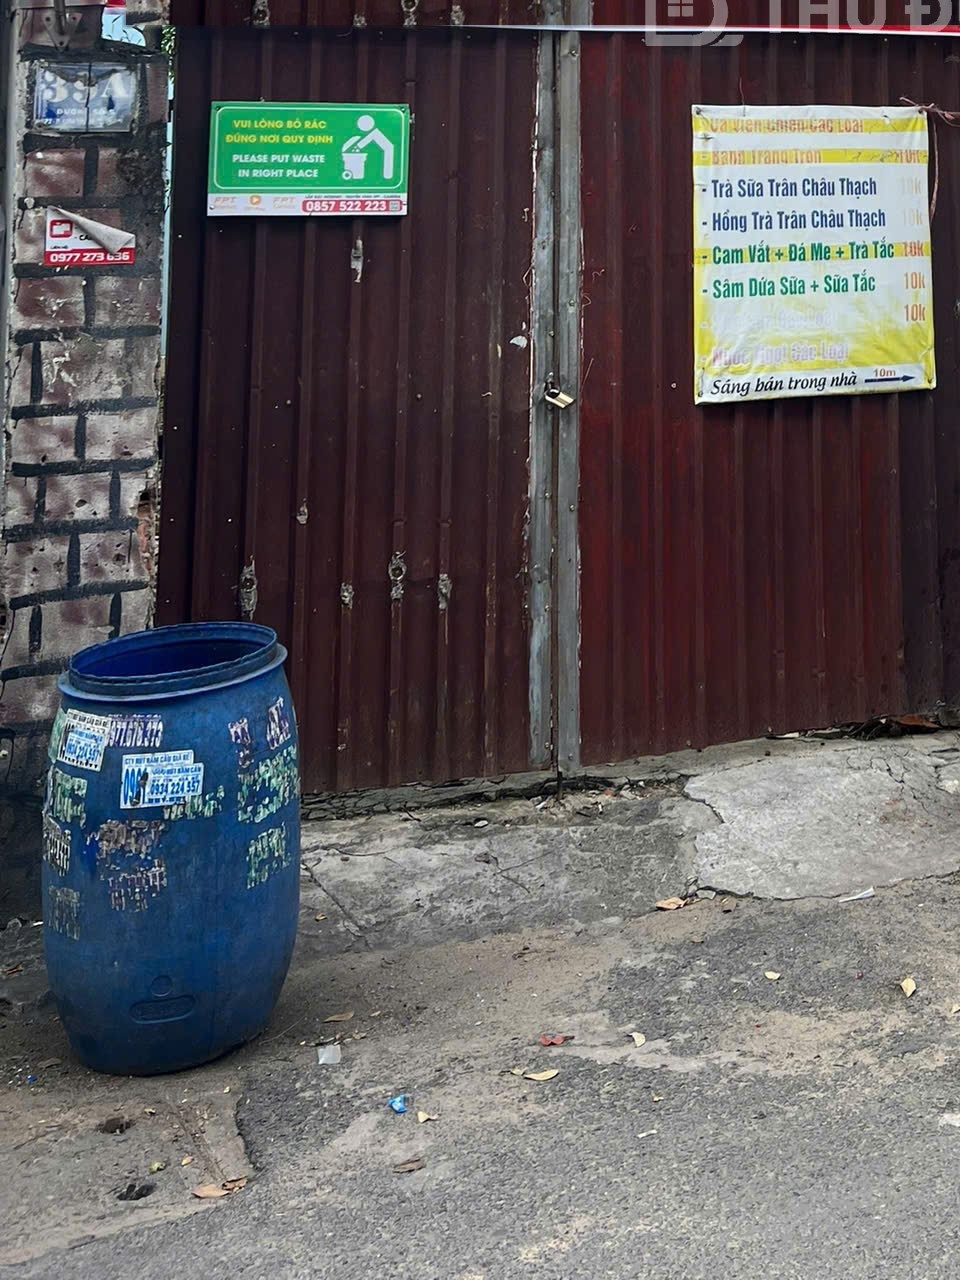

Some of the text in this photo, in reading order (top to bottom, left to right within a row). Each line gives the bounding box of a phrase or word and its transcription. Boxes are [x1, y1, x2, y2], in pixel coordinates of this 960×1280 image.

[233, 118, 327, 129] VUI LÒNG BỎ RÁC
[225, 132, 333, 145] ĐÚNG NƠI QUY ĐỊNH
[232, 154, 325, 163] PLEASE PUT WASTE
[238, 169, 318, 178] IN RIGHT PLACE
[712, 178, 733, 198] Trà
[738, 178, 764, 198] Sữa
[768, 178, 797, 197] Trân
[802, 178, 835, 197] Châu
[839, 177, 877, 199] Thạch
[306, 200, 336, 211] 0857
[339, 200, 361, 211] 522
[364, 200, 386, 211] 223
[712, 209, 747, 233] Hồng
[752, 210, 773, 230] Trà
[777, 210, 807, 229] Trân
[811, 209, 844, 228] Châu
[848, 208, 886, 232] Thạch
[50, 253, 80, 262] 0977
[82, 253, 105, 262] 273
[712, 245, 744, 264] Cam
[748, 240, 770, 263] Vắt
[789, 242, 806, 262] Đá
[811, 242, 831, 261] Me
[849, 240, 868, 259] Trà
[872, 236, 895, 258] Tắc
[712, 269, 925, 299] Sâm Dứa Sữa Sữa Tắc 10k
[904, 304, 926, 322] 10k
[710, 368, 896, 398] Sáng bán trong nhà 10m
